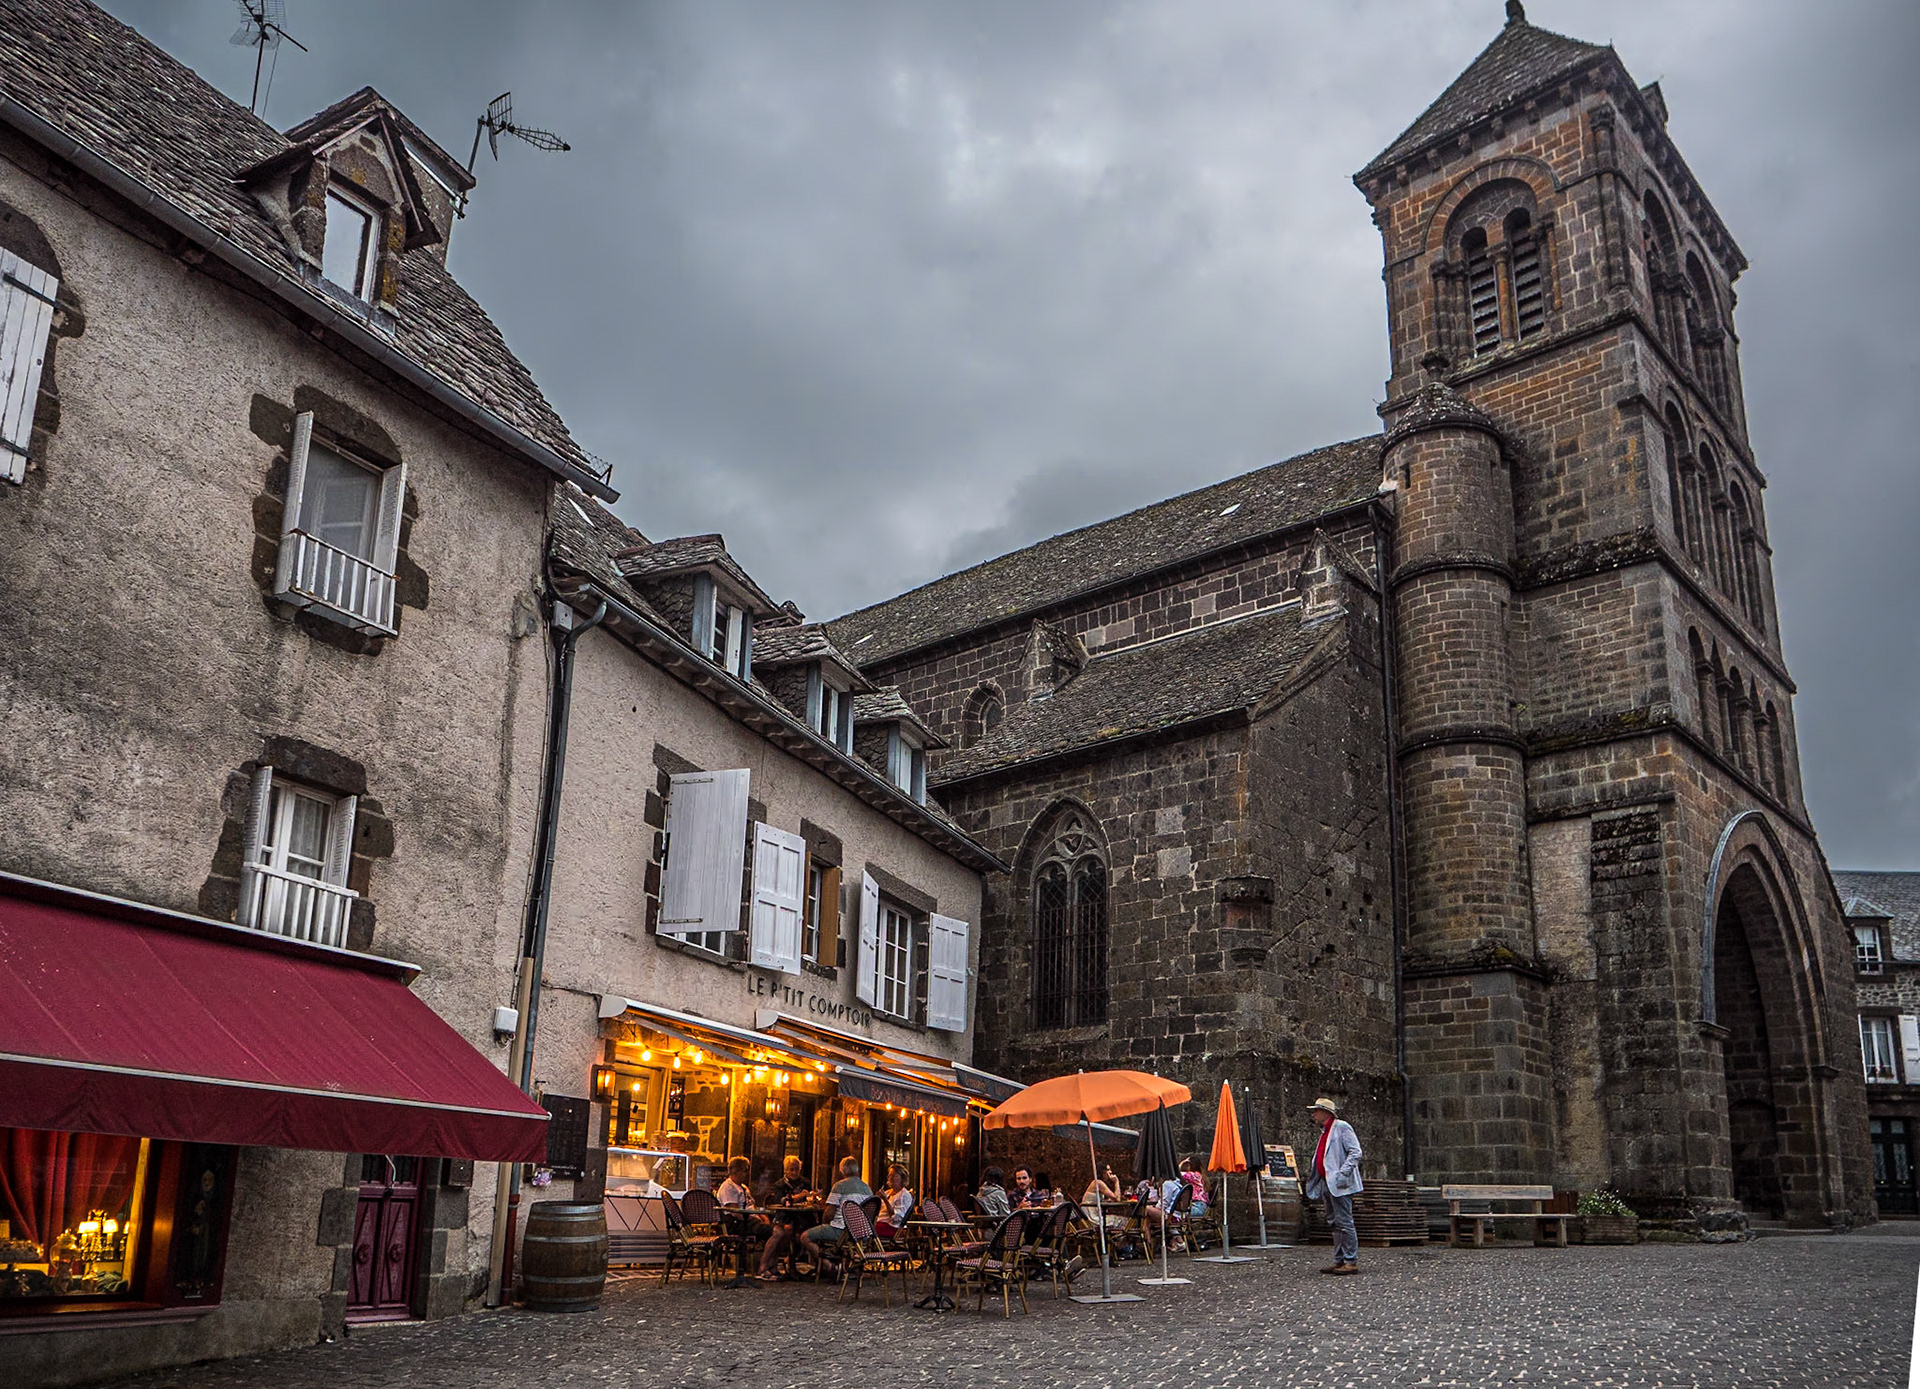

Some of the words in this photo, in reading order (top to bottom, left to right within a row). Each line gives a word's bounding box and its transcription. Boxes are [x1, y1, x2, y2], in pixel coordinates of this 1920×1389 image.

[748, 973, 765, 995] LE
[771, 982, 804, 1008] P'TIT
[809, 995, 871, 1029] COMPTOIR
